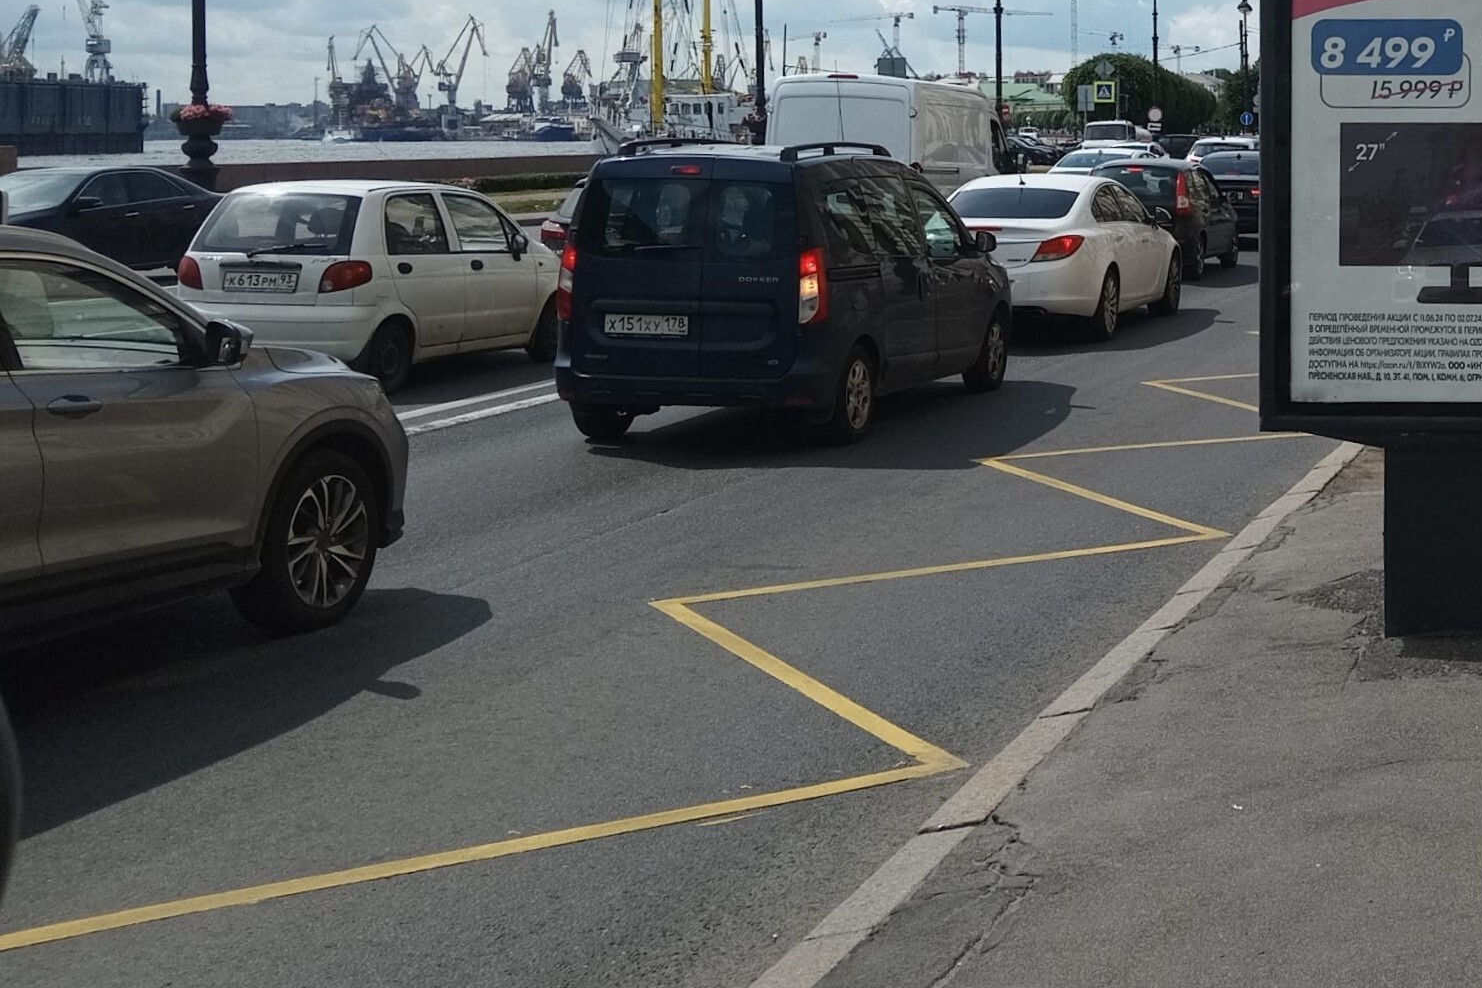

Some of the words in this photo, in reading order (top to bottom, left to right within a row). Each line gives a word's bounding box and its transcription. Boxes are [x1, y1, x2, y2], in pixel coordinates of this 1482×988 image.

[1319, 36, 1347, 69] 8
[1356, 36, 1436, 69] 499
[1309, 313, 1337, 322] ПЕРИОД
[1339, 313, 1385, 322] ПРОВЕДЕНИЯ
[1387, 313, 1411, 323] АКЦИИ
[1445, 314, 1455, 323] ПО
[1370, 325, 1409, 334] ВРЕМЕННОЙ
[1411, 325, 1457, 334] ПРОМЕЖУТОК
[1309, 336, 1341, 345] ДЕЙСТВИЯ
[1343, 337, 1377, 346] ЦЕНОВОГО
[1379, 337, 1426, 346] ПРЕДЛОЖЕНИЯ
[1427, 337, 1457, 346] УКАЗАНО
[1459, 337, 1468, 346] НА
[1309, 349, 1354, 357] ИНФОРМАЦИЯ
[1355, 349, 1365, 357] ОБ
[1438, 349, 1470, 358] ПРАВИЛАХ
[1309, 360, 1347, 369] ДОСТУПНА
[1349, 360, 1359, 369] НА
[1448, 361, 1465, 370] ООО
